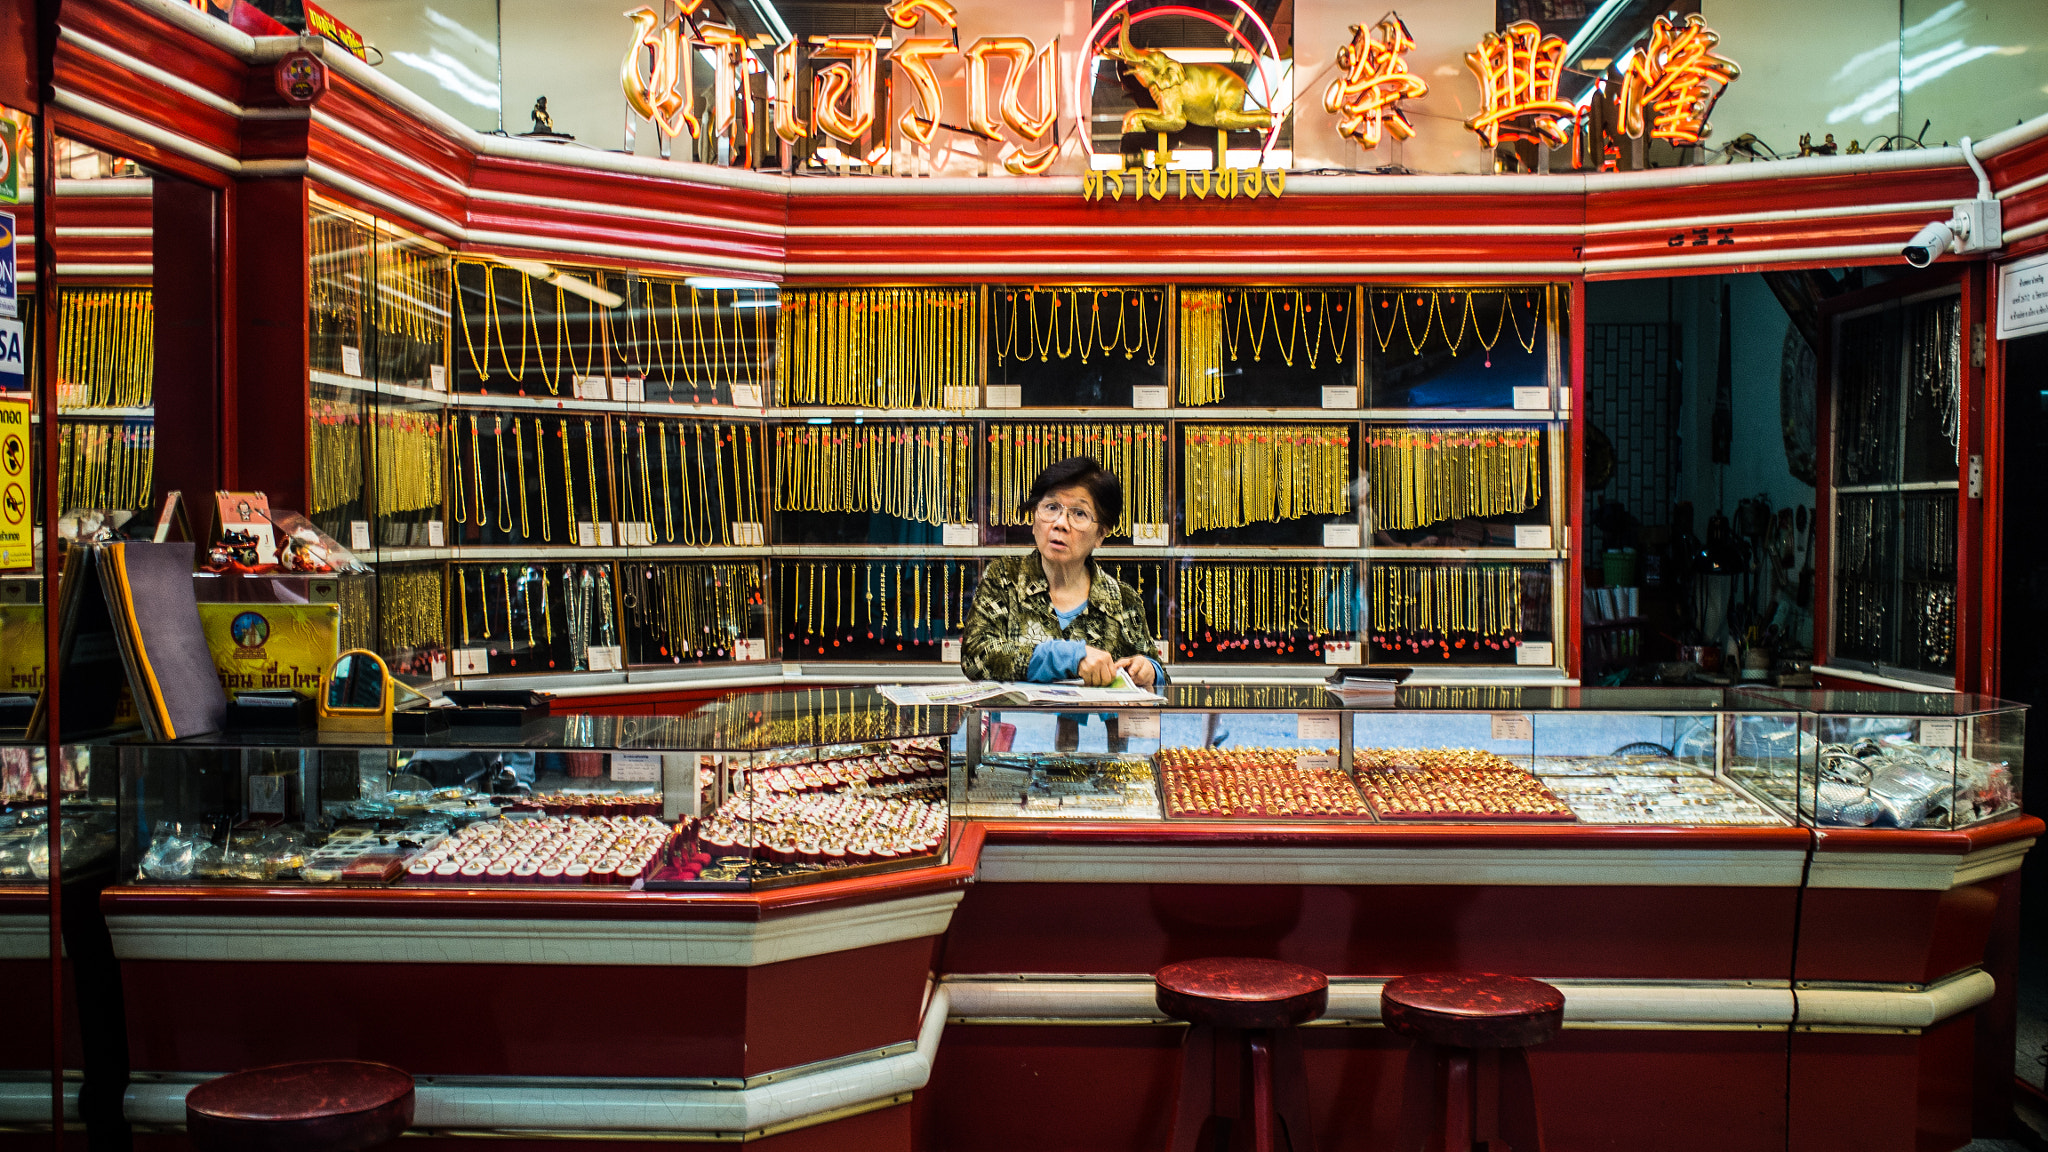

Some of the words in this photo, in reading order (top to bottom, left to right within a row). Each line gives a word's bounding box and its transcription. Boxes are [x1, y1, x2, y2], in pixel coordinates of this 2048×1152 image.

[1083, 149, 1286, 202] ตราช้างทอง
[0, 330, 21, 363] SA
